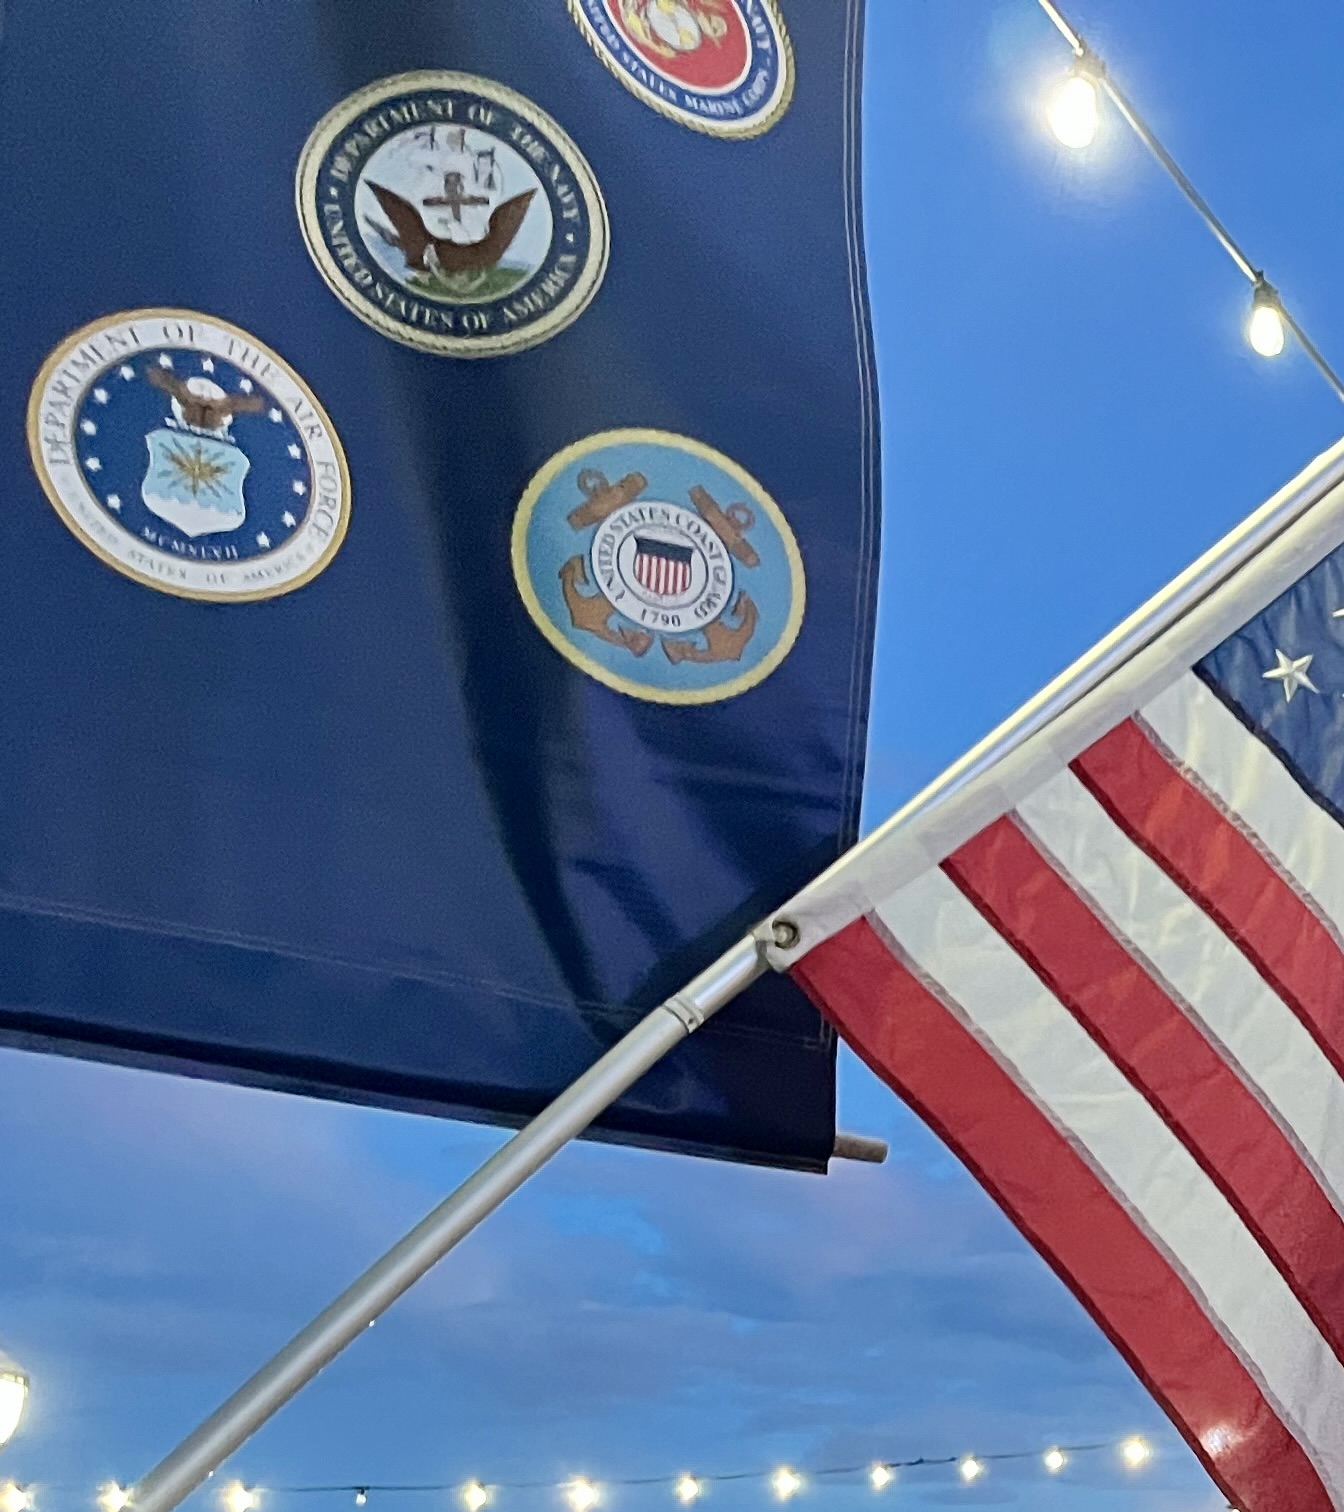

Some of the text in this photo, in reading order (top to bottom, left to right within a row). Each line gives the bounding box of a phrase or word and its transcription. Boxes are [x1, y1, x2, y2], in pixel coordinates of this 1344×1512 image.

[331, 98, 582, 225] DEPARTMENT OF THE NAVY
[683, 94, 745, 115] MARINE
[323, 203, 578, 332] UNITED STATES OF AMERICA
[44, 323, 337, 542] DEPARTMENT OF THE AIR FORCE
[598, 507, 728, 619] UNITED STATES COAST GUARD
[641, 608, 682, 628] 1790
